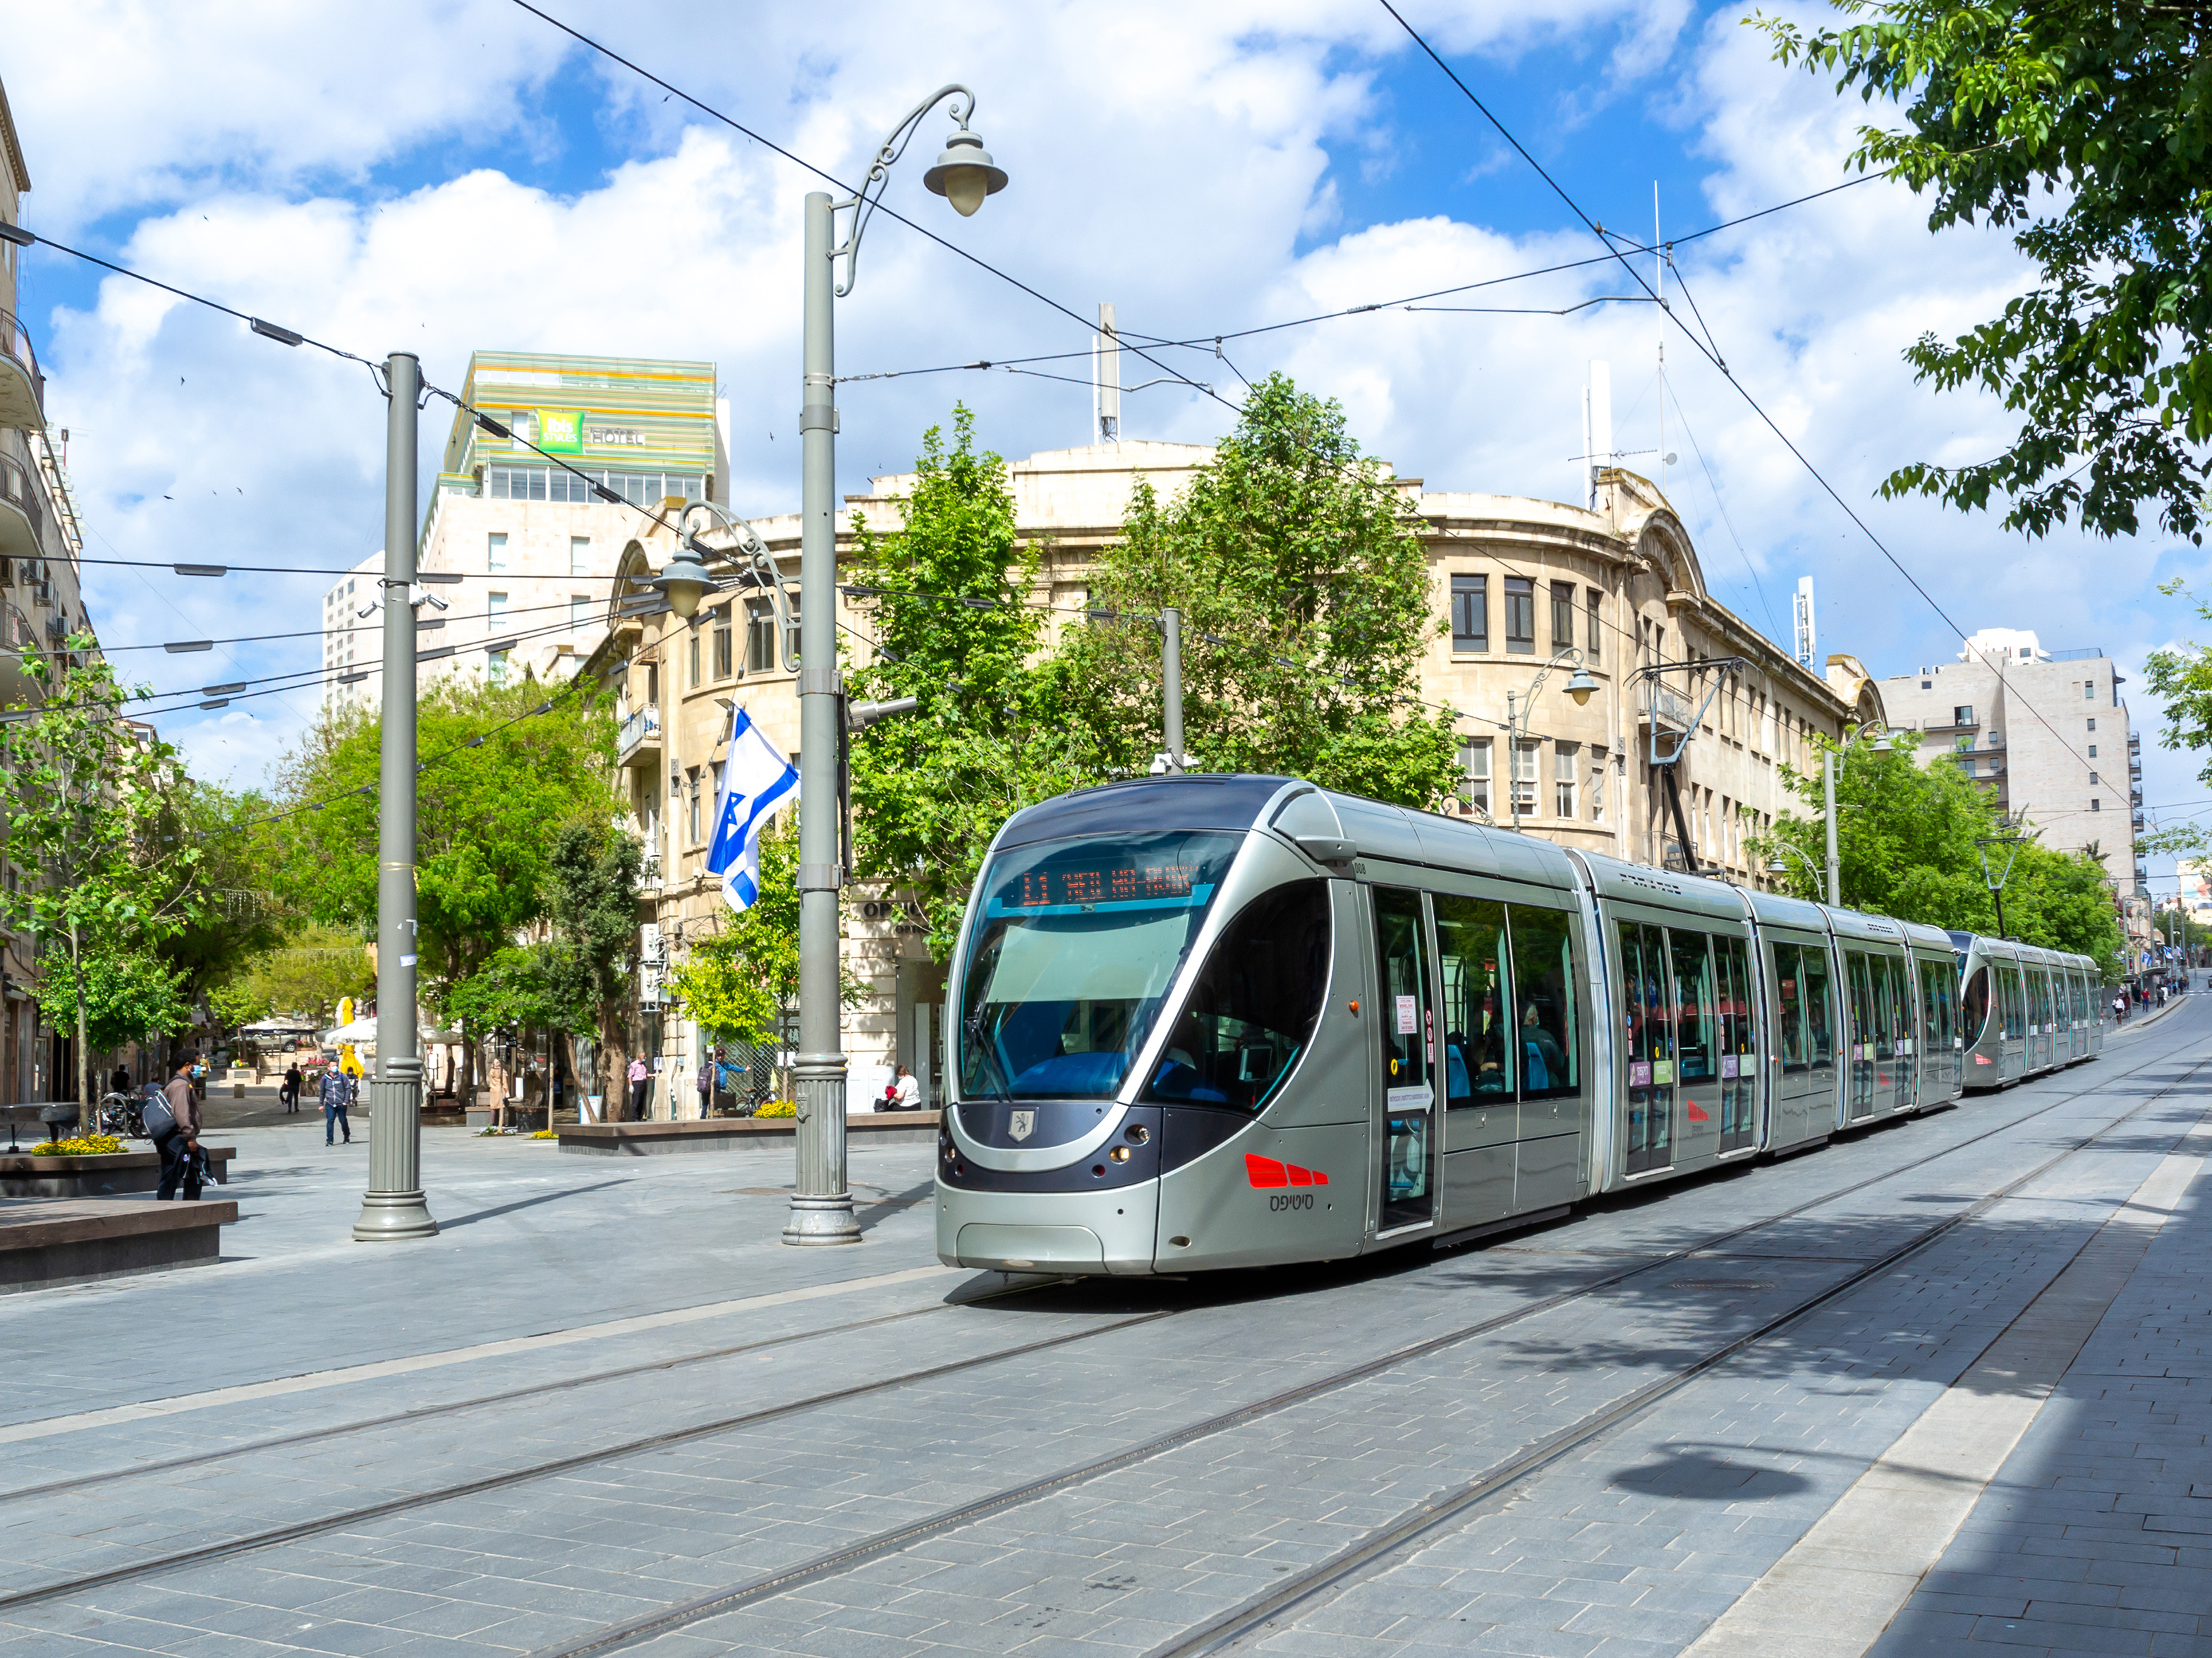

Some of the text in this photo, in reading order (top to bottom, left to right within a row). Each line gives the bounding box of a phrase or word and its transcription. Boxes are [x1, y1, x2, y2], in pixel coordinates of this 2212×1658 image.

[547, 418, 573, 433] ibis
[590, 427, 645, 445] HOTEL
[1354, 862, 1366, 875] 008
[1270, 1194, 1314, 1211] סיטיפס
